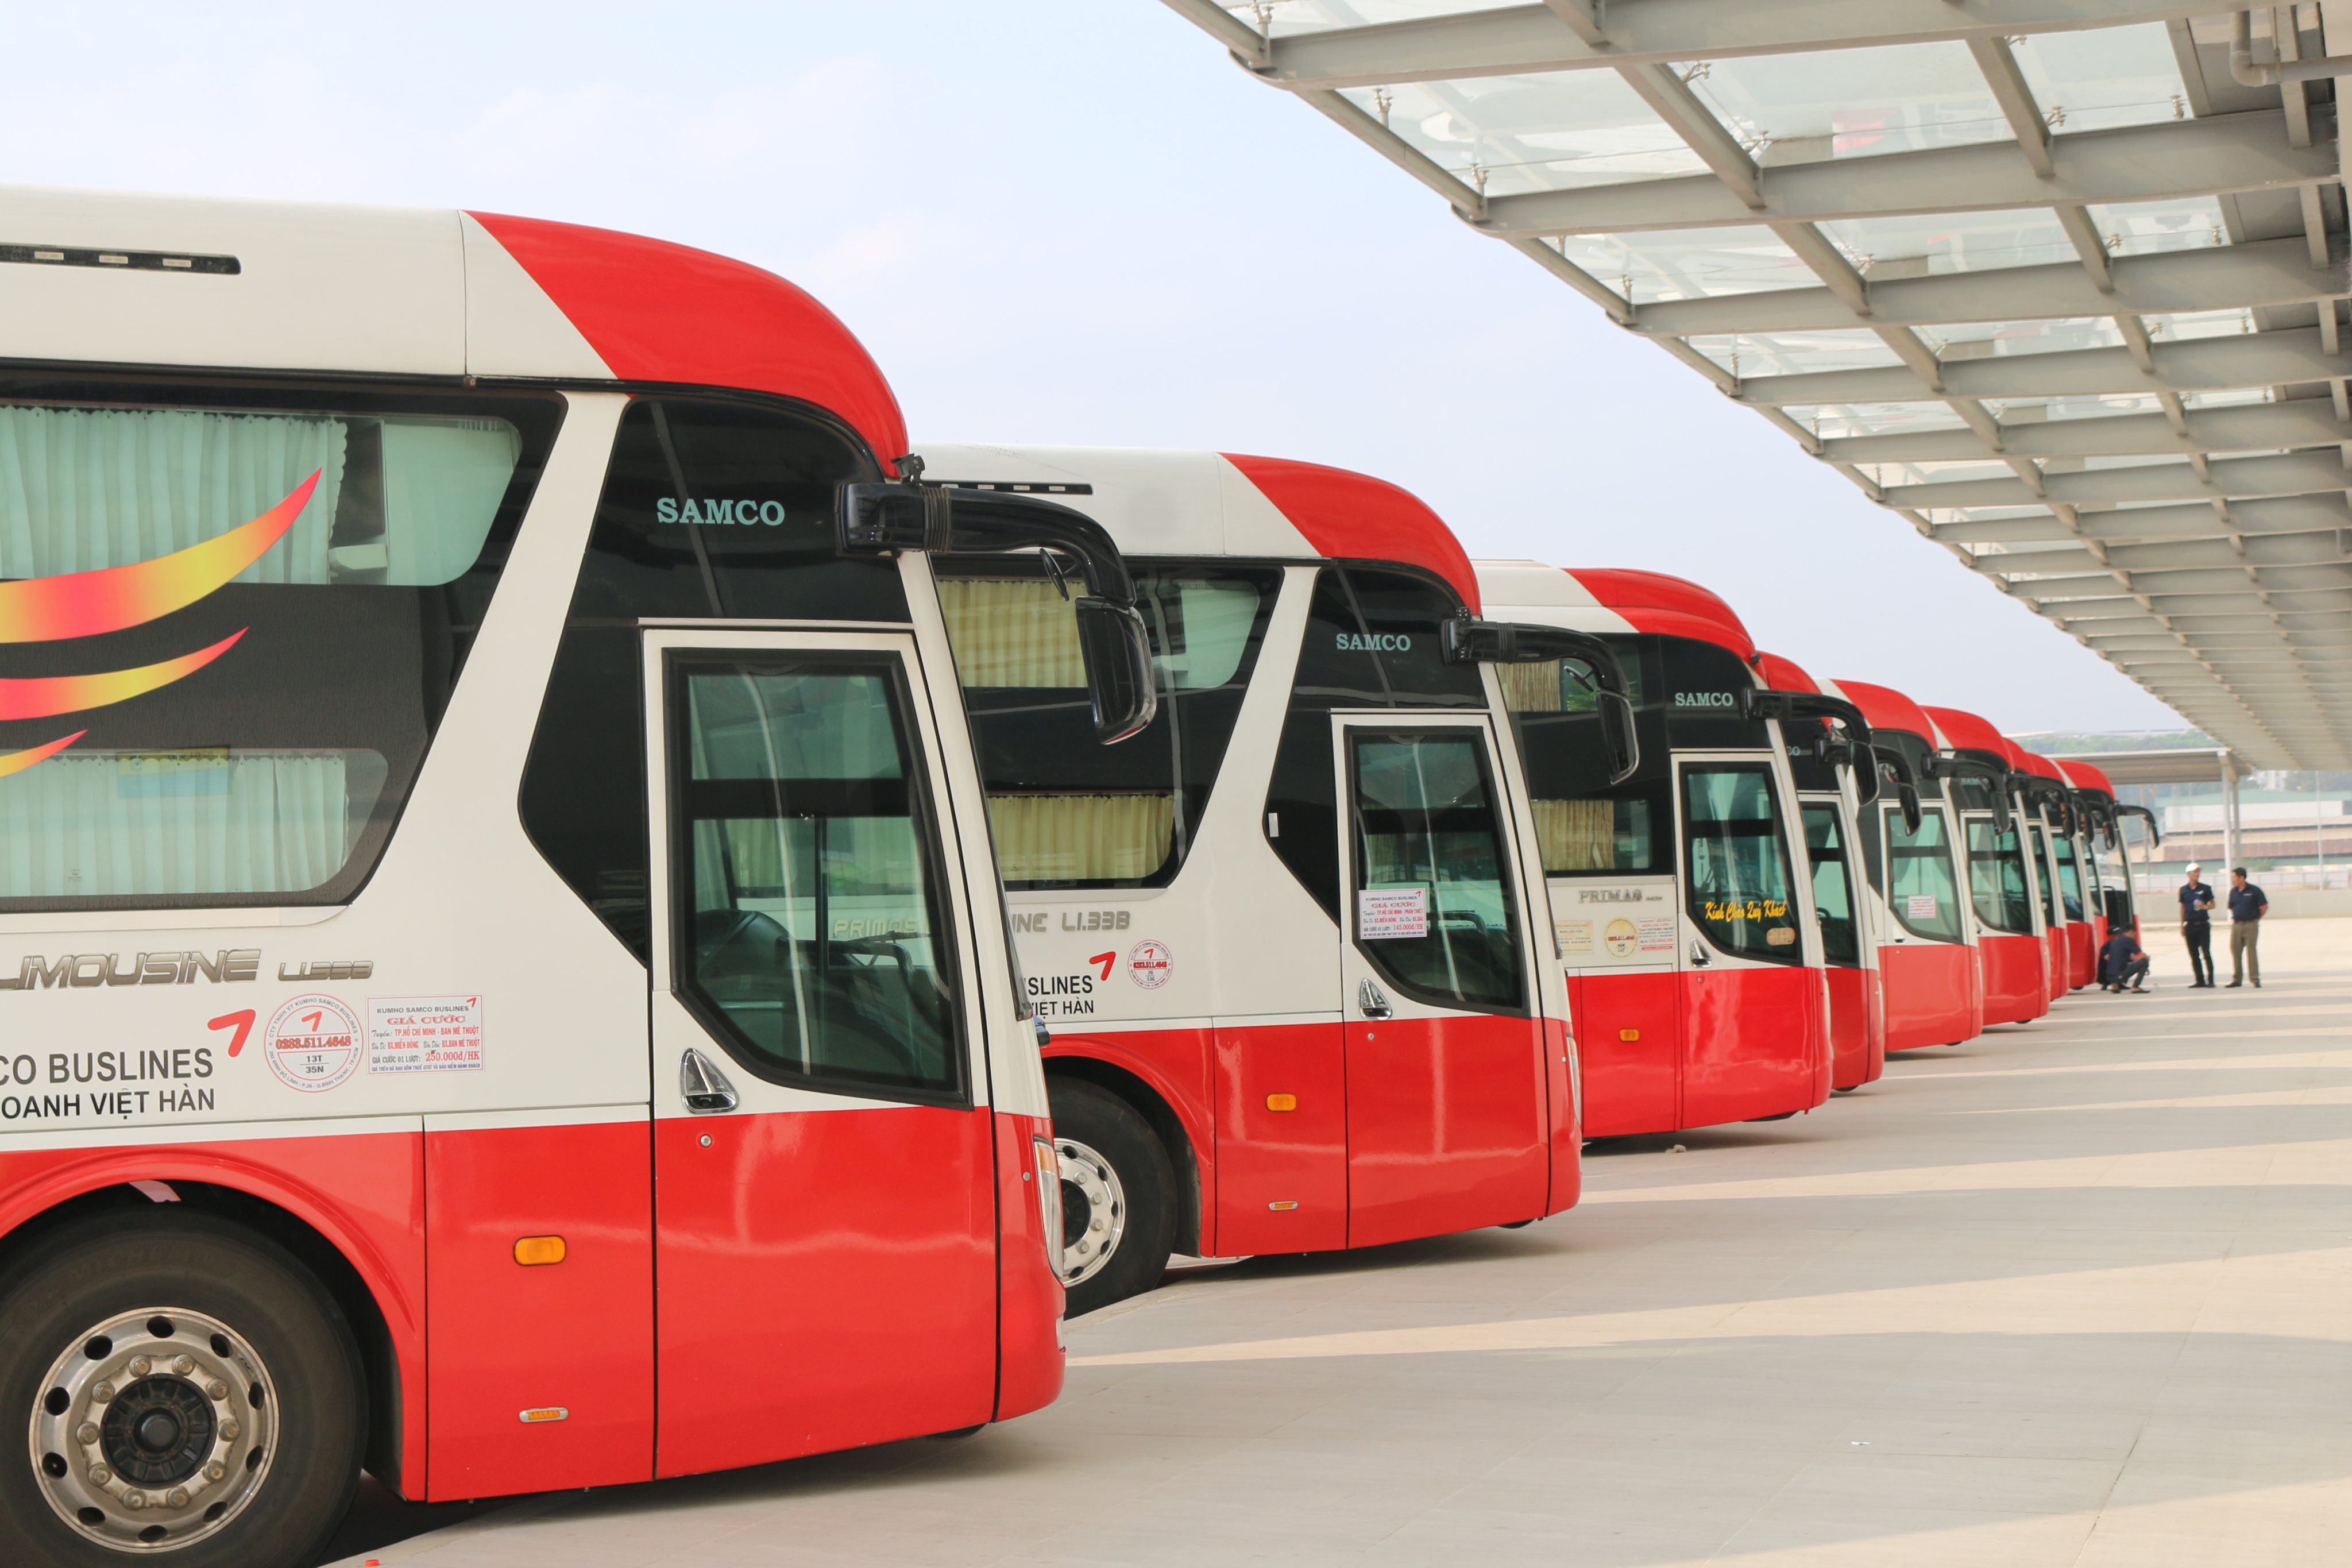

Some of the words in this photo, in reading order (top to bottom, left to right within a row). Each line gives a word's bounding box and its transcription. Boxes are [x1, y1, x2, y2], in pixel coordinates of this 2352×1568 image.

[656, 497, 785, 526] SAMCO
[1335, 633, 1411, 651] SAMCO
[1674, 692, 1734, 706] SAMCO
[1024, 975, 1094, 996] SLINES
[274, 1010, 287, 1025] TNHH
[295, 998, 317, 1007] KUMHO
[318, 998, 340, 1009] SAMCO
[339, 1007, 358, 1034] BUSLINES
[1032, 999, 1058, 1019] IỆT
[1063, 997, 1094, 1015] HÀN
[387, 1015, 417, 1025] GIÁ
[420, 1014, 466, 1024] CƯỚC
[412, 1026, 421, 1036] CHÍ
[422, 1028, 436, 1036] MINH
[441, 1027, 451, 1035] BAN
[49, 1048, 214, 1084] BUSLINES
[306, 1055, 323, 1063] 13T
[372, 1055, 381, 1064] GIÁ
[305, 1065, 325, 1074] 35N
[1, 1093, 81, 1119] OANH
[90, 1087, 150, 1120] VIỆT
[159, 1083, 215, 1113] HÀN
